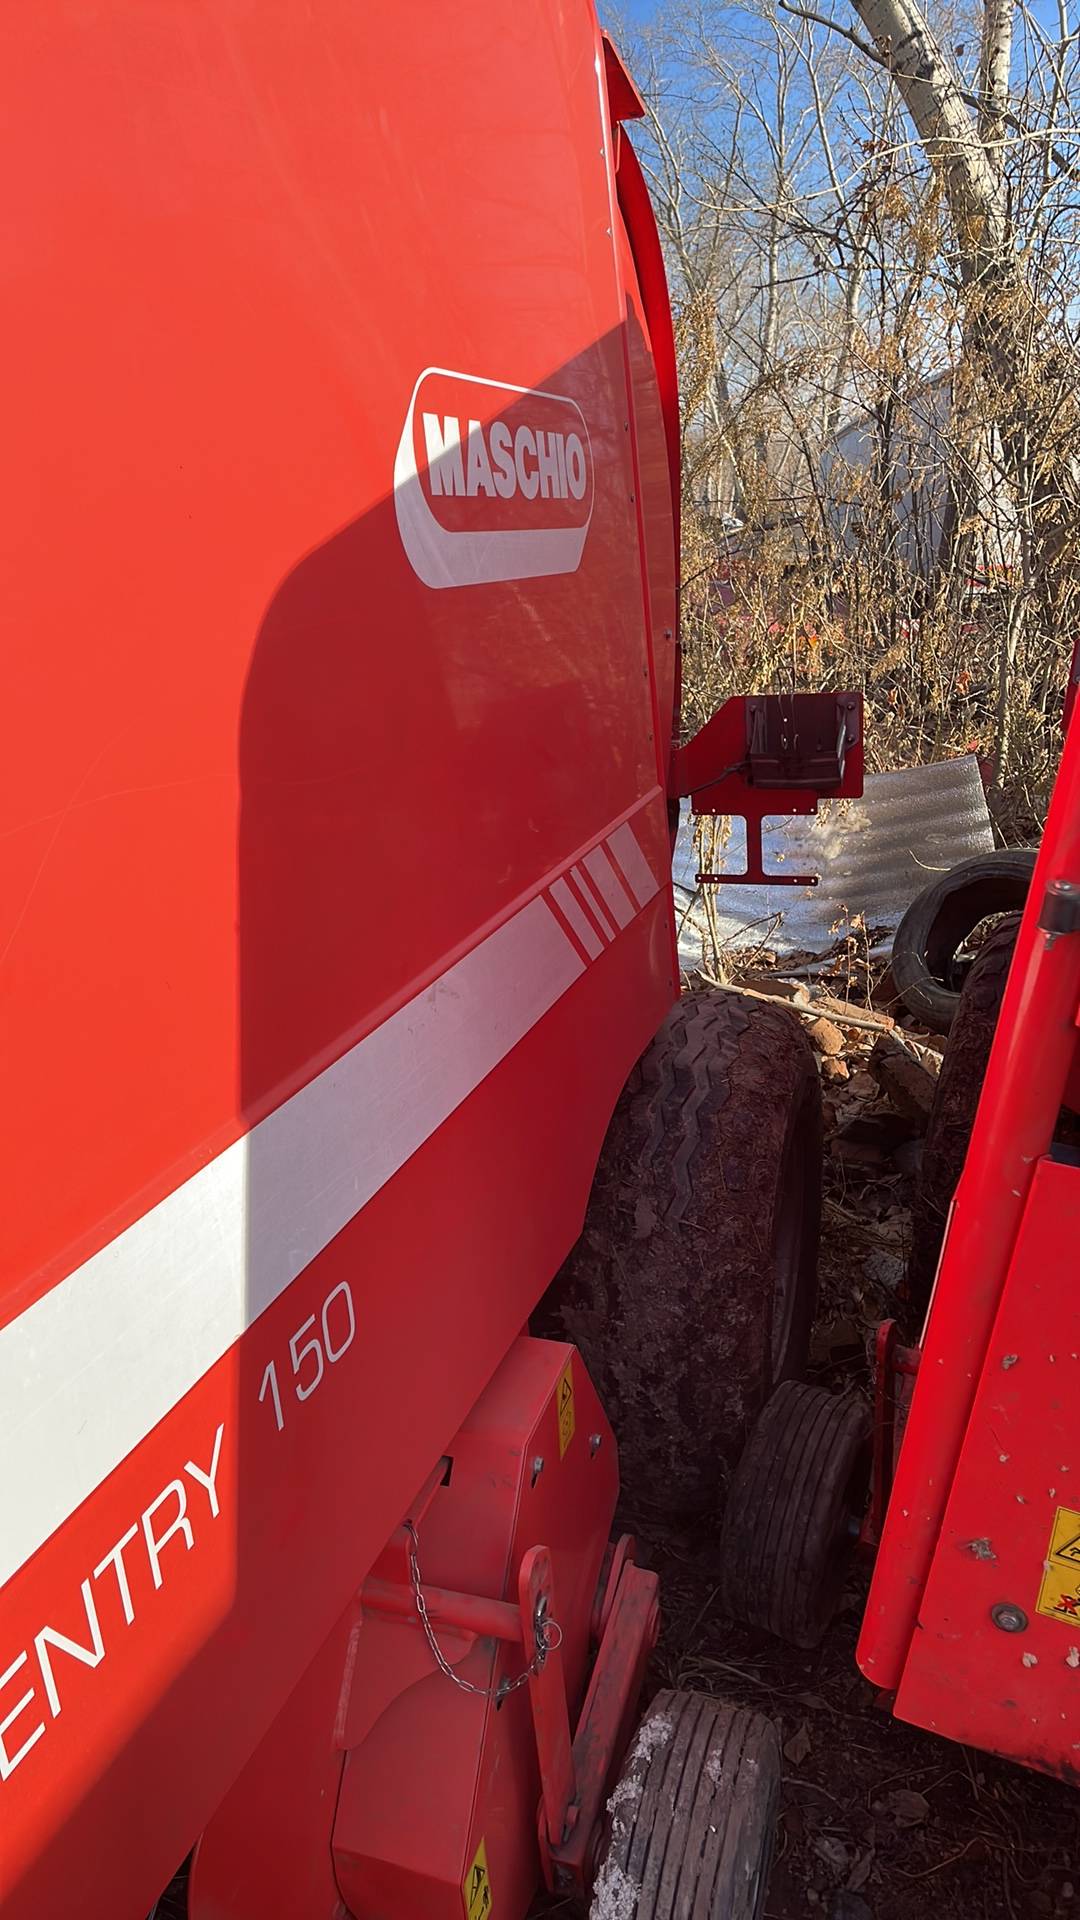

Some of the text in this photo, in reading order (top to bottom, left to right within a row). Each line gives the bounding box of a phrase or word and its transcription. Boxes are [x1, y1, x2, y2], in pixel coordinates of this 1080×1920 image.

[422, 412, 587, 500] MASCHIO
[0, 1280, 357, 1781] ENTRY 150
